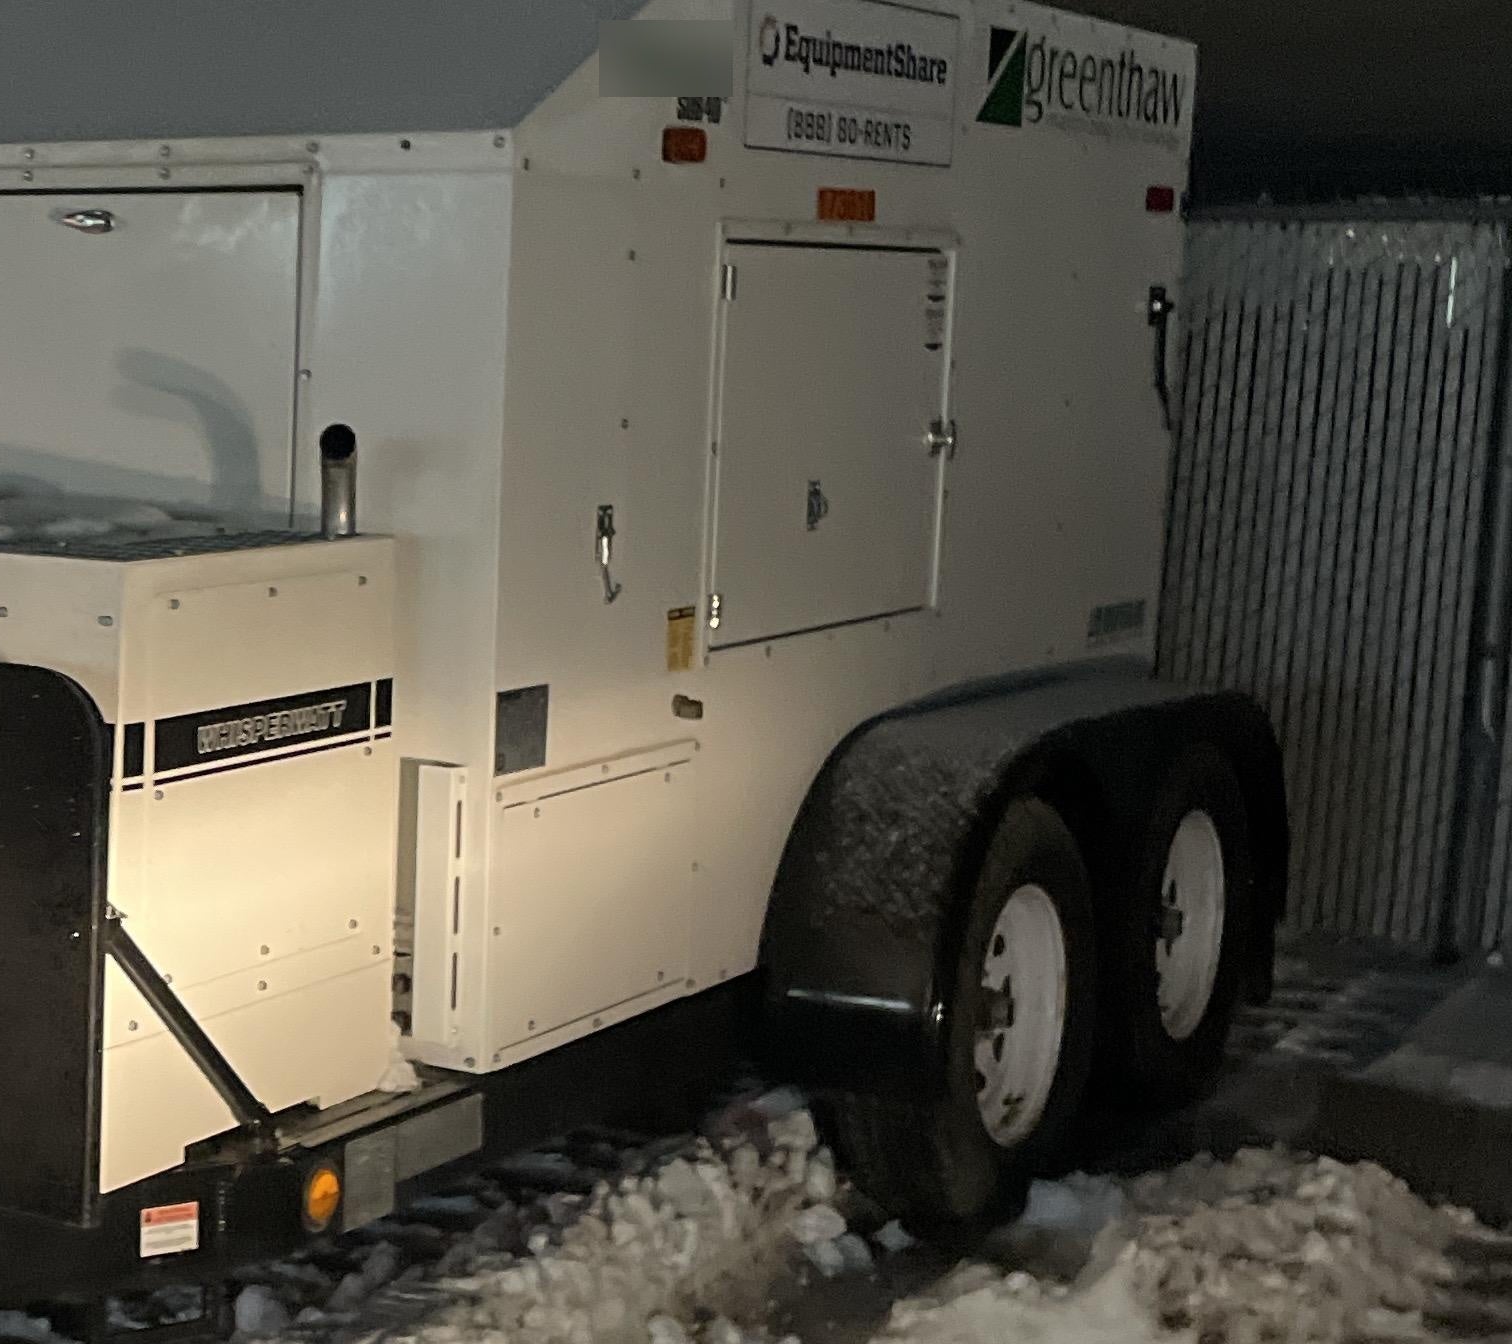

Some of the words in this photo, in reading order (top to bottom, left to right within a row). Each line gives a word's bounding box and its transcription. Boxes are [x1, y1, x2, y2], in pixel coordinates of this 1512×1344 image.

[785, 23, 948, 84] EquipmentShare
[1025, 35, 1186, 126] greenthaw
[788, 108, 833, 143] (888)
[838, 116, 912, 150] 80-RENTS
[197, 699, 347, 754] WHISPERWATT
